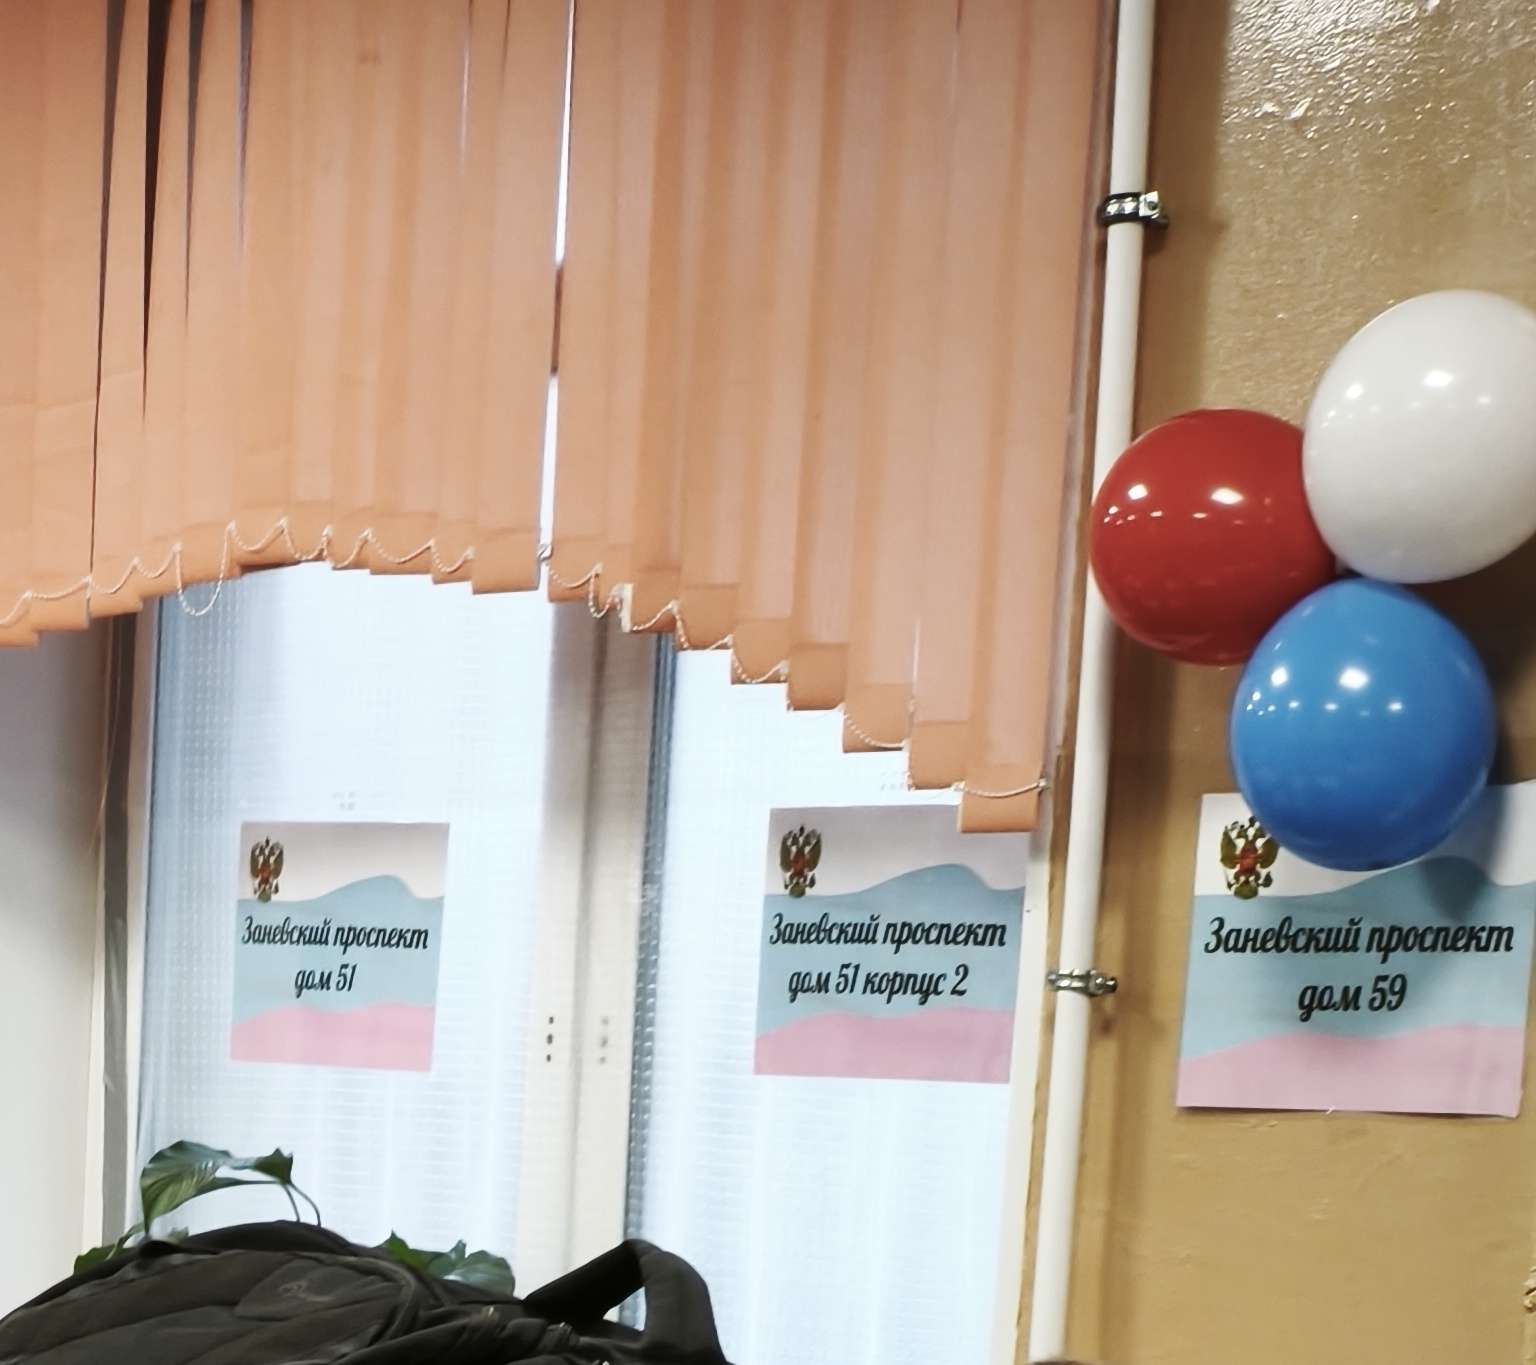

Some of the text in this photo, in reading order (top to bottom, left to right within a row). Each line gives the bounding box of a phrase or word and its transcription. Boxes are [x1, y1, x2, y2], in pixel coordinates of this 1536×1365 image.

[242, 914, 429, 956] Заневский проспект
[769, 912, 1007, 955] Заневский проспект
[1204, 915, 1514, 965] Заневский проспект
[294, 962, 358, 999] дом 51
[788, 962, 970, 1006] дом 51 корпус 2
[1298, 973, 1408, 1023] дом 59
